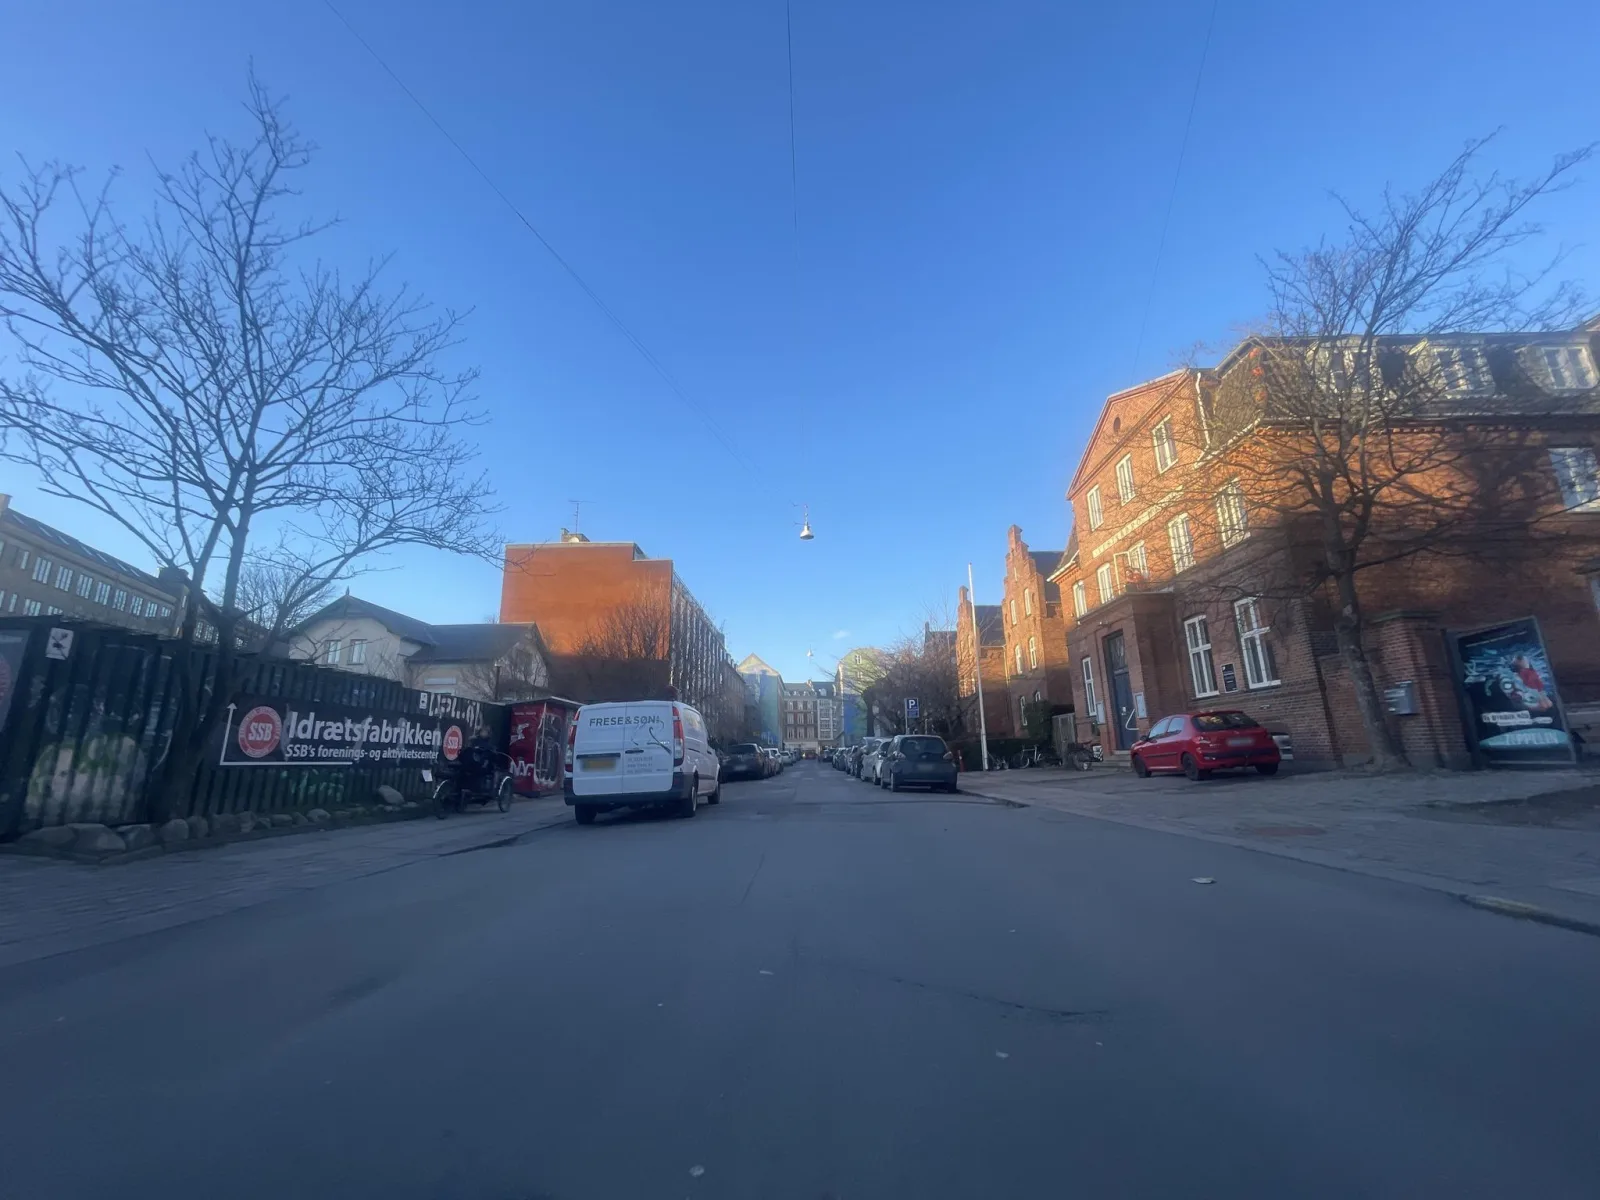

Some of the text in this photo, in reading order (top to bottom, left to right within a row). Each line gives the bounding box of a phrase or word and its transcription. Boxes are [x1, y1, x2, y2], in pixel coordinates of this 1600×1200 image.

[909, 699, 916, 708] P
[248, 722, 273, 741] SSB
[288, 711, 442, 746] Idrætsfabrikken
[285, 744, 316, 758] SSB's
[317, 745, 368, 761] forenings-
[369, 749, 381, 761] og
[382, 747, 439, 760] aktivitetscenter
